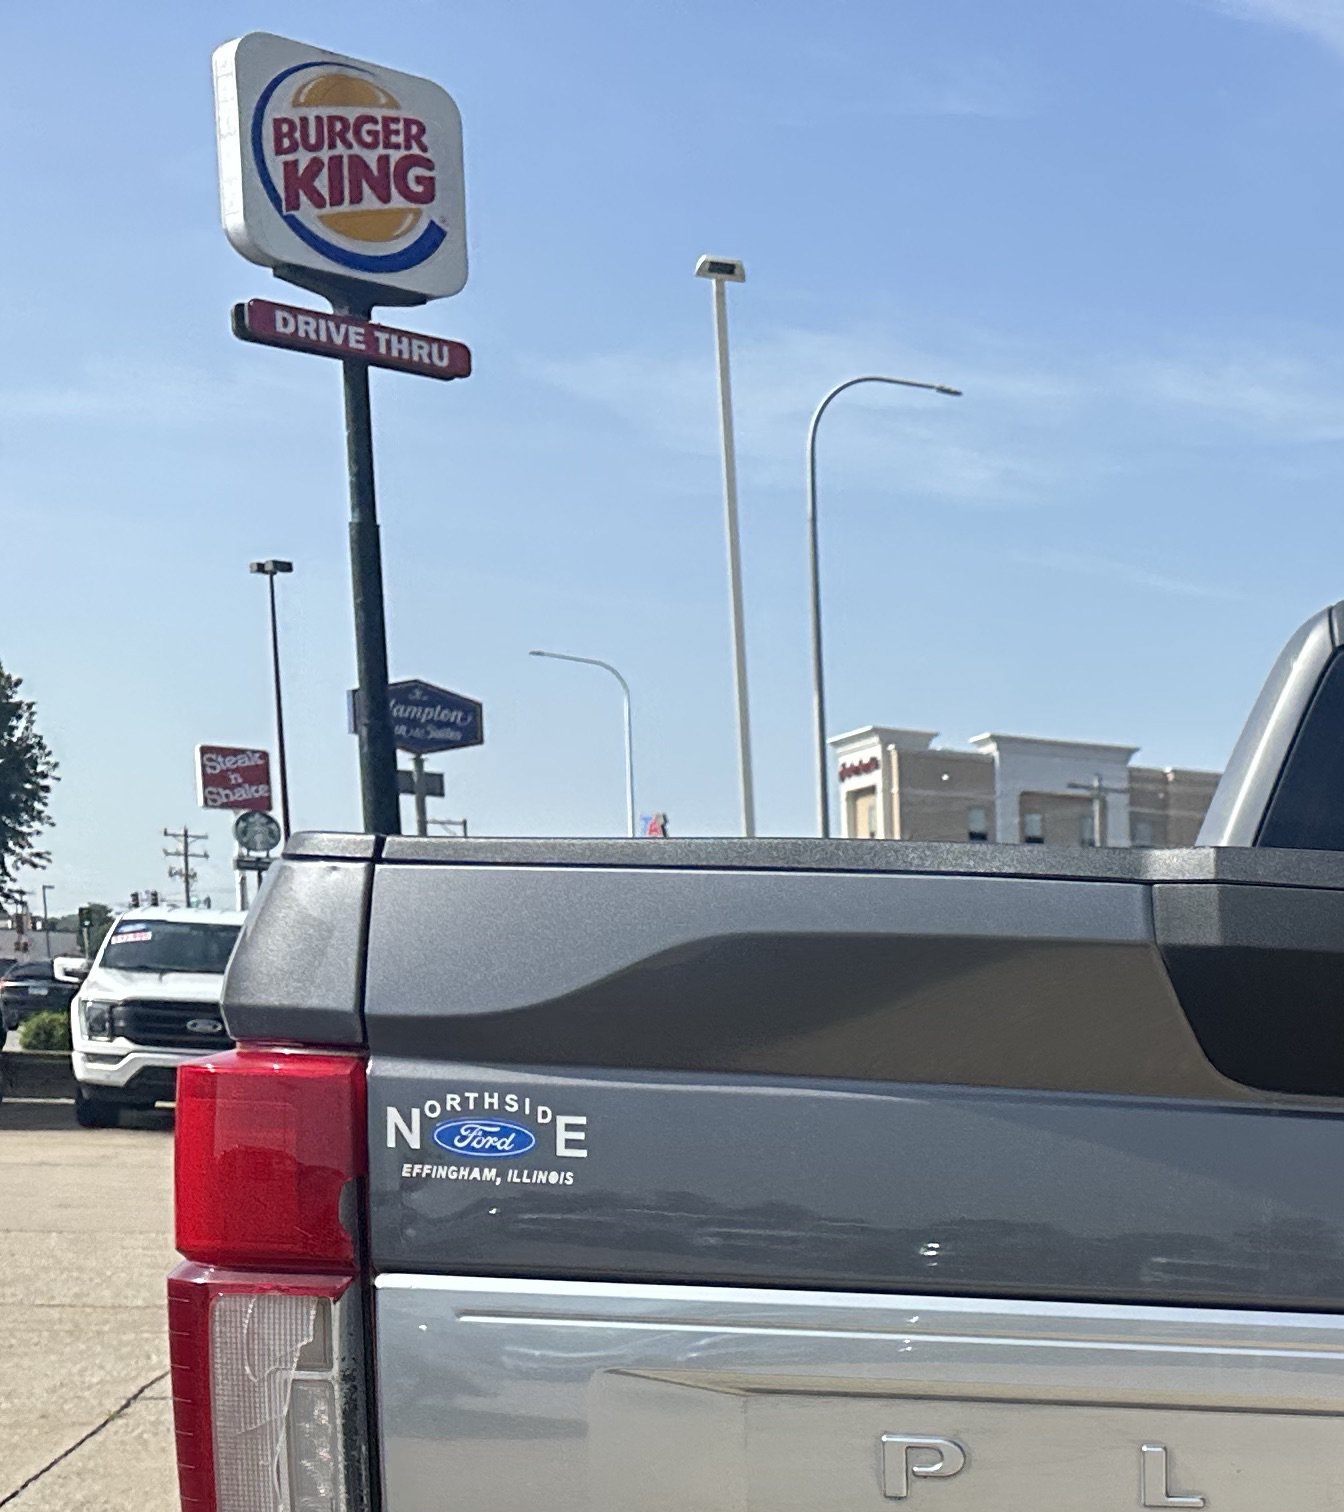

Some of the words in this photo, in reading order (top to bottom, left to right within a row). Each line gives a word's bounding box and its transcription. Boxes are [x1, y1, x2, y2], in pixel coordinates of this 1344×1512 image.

[272, 114, 428, 156] BURGER
[282, 153, 436, 212] KING
[275, 310, 366, 350] DRIVE
[374, 330, 450, 368] THRU
[389, 699, 474, 726] ampton
[203, 751, 264, 775] Steak
[204, 783, 270, 807] Shake
[386, 1092, 588, 1158] NORTHSIDE
[453, 1123, 516, 1151] Ford
[401, 1163, 502, 1186] EFFINGHAM,
[507, 1168, 575, 1186] ILLINOIS
